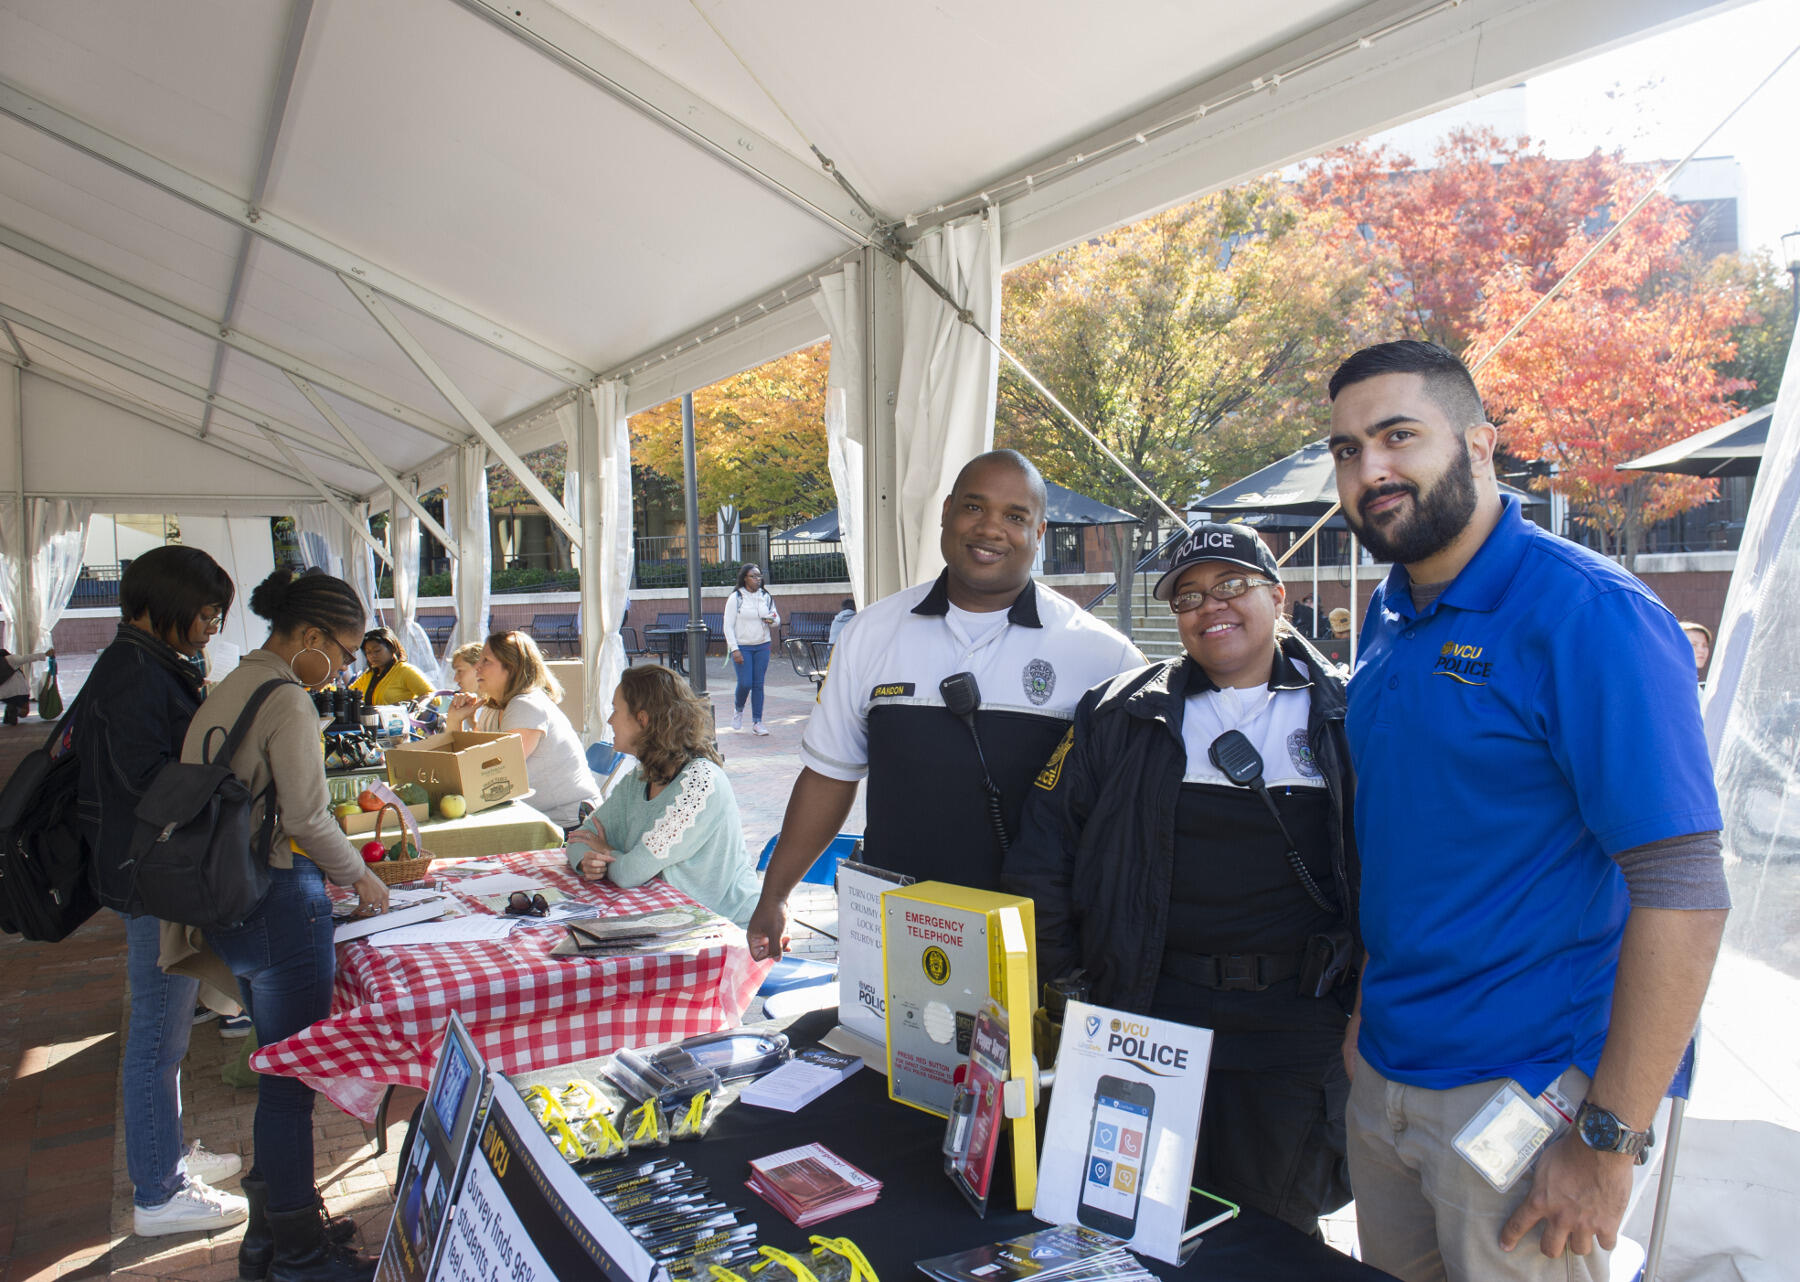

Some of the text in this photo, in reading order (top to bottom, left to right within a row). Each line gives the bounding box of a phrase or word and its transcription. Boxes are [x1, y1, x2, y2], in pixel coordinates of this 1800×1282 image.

[1175, 532, 1235, 566] POLICE
[1453, 643, 1483, 659] VCU
[1434, 656, 1494, 677] POLICE
[848, 886, 881, 904] TURN OVE
[850, 901, 878, 918] CRUMMY
[856, 918, 875, 932] LOCK
[905, 911, 965, 933] EMERGENCY
[850, 930, 874, 947] STURDY
[907, 925, 964, 947] TELEPHONE
[859, 990, 886, 1012] POLIC
[1121, 1022, 1150, 1038] VCU
[897, 1050, 950, 1073] PRESS RED BUTTON
[1107, 1033, 1189, 1070] POLICE
[489, 1130, 510, 1178] VCU
[467, 1168, 493, 1234] Survey
[491, 1212, 513, 1268] finds
[448, 1235, 464, 1278] feel
